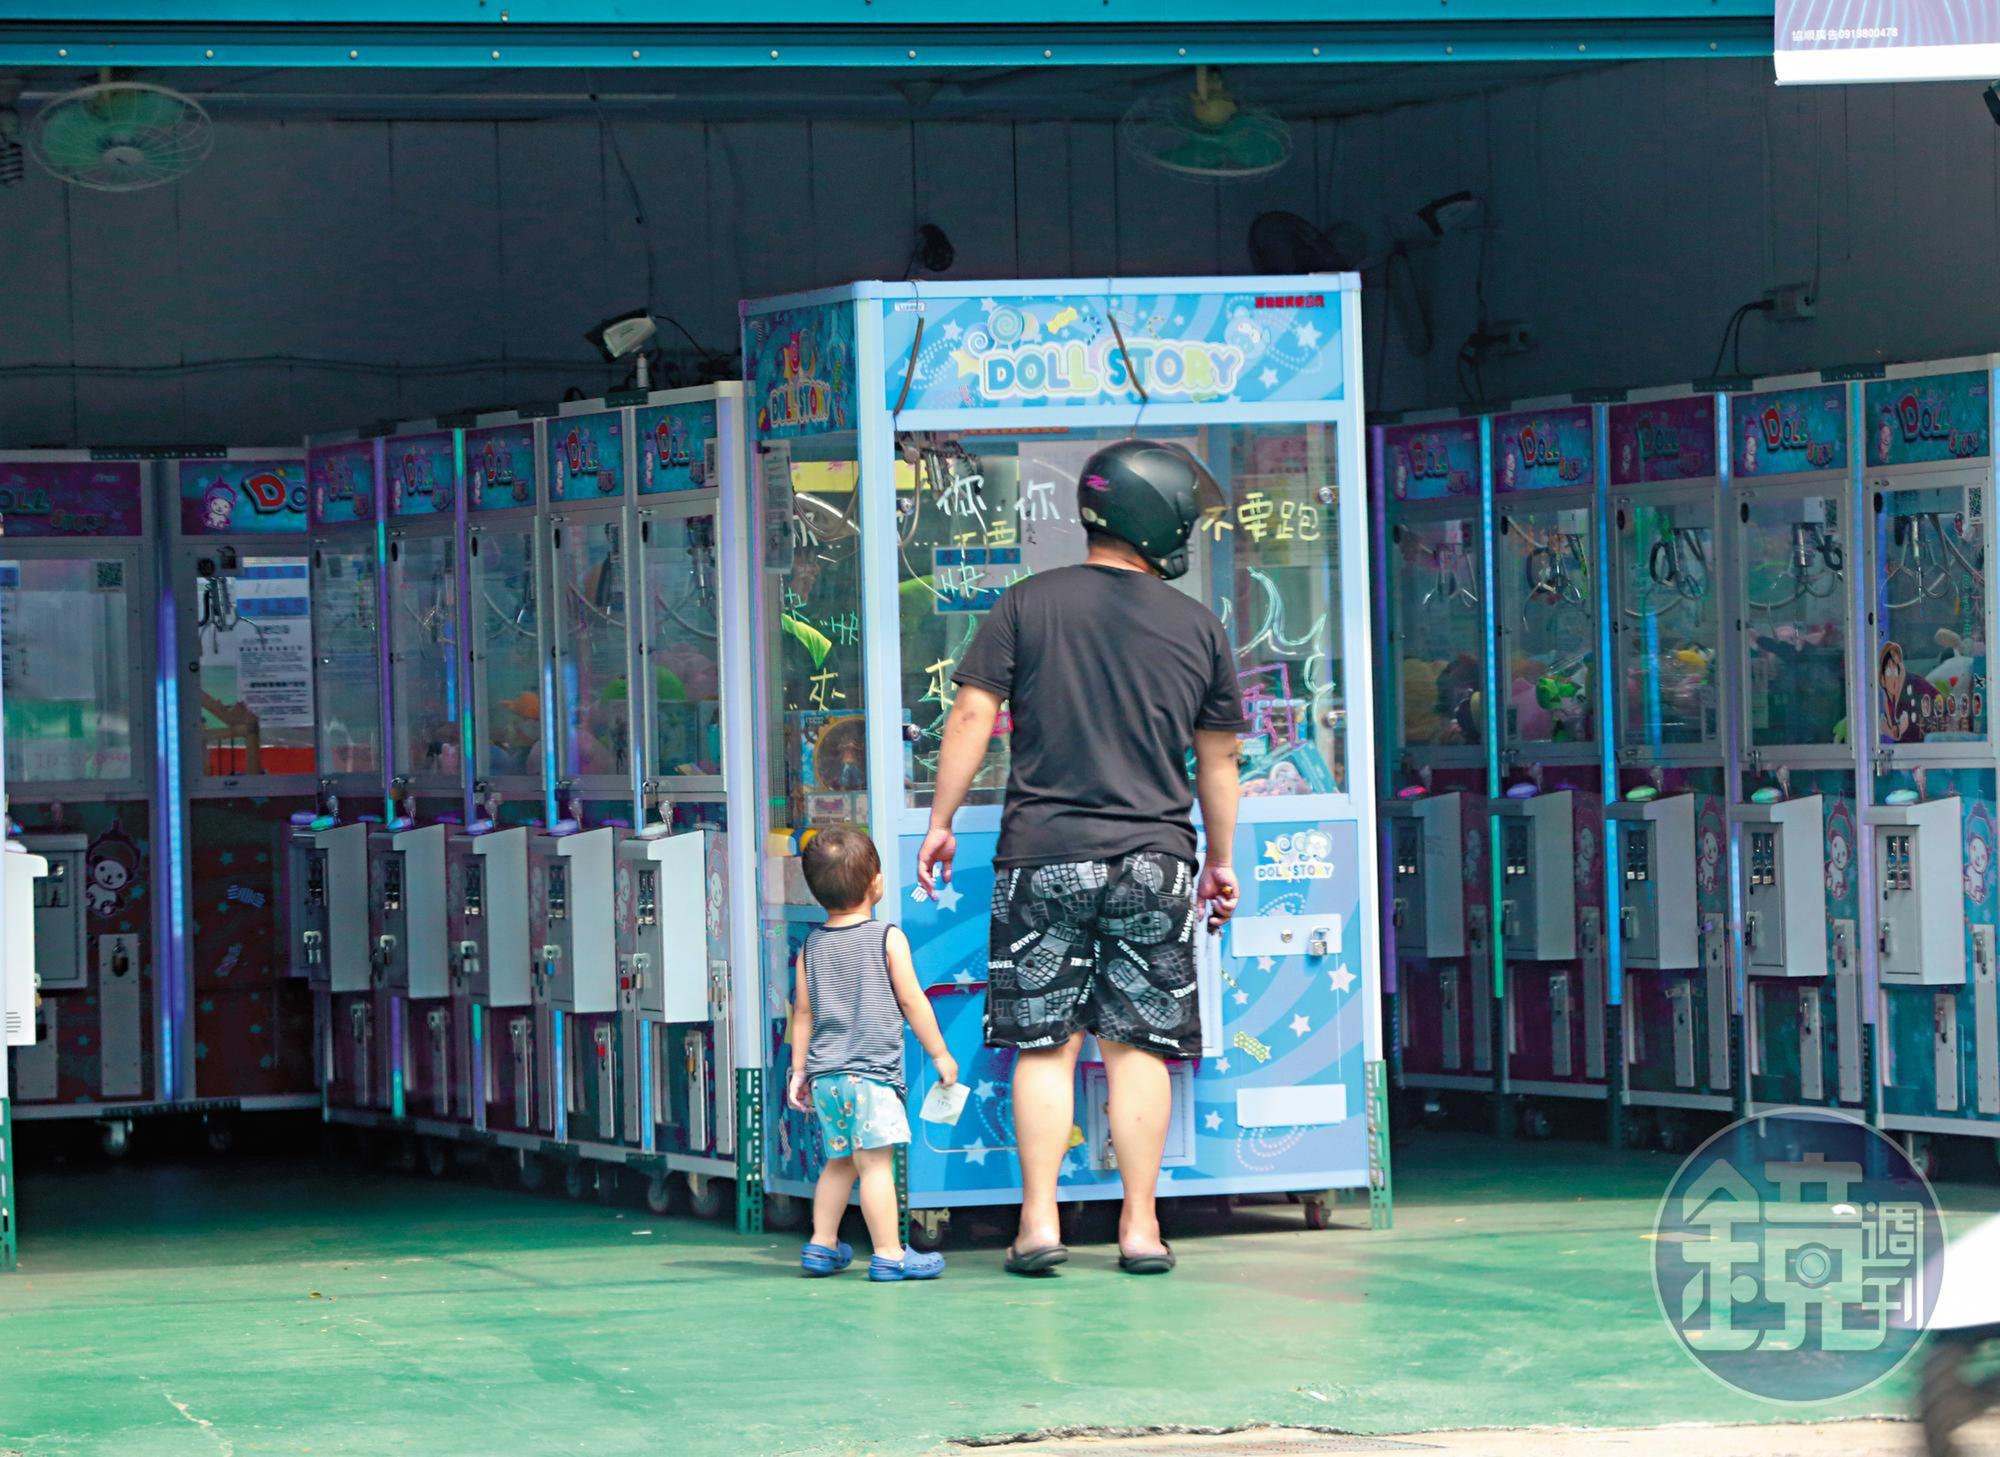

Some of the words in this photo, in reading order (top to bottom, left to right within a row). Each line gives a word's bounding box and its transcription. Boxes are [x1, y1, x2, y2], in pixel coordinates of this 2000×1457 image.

[986, 346, 1097, 392] DOLL
[1106, 346, 1241, 390] STORY
[241, 472, 307, 514] DO
[1201, 491, 1321, 542] 不要跑
[1257, 864, 1292, 878] DOLL
[1292, 864, 1332, 878] STORY
[1116, 939, 1150, 972] TRAVEL
